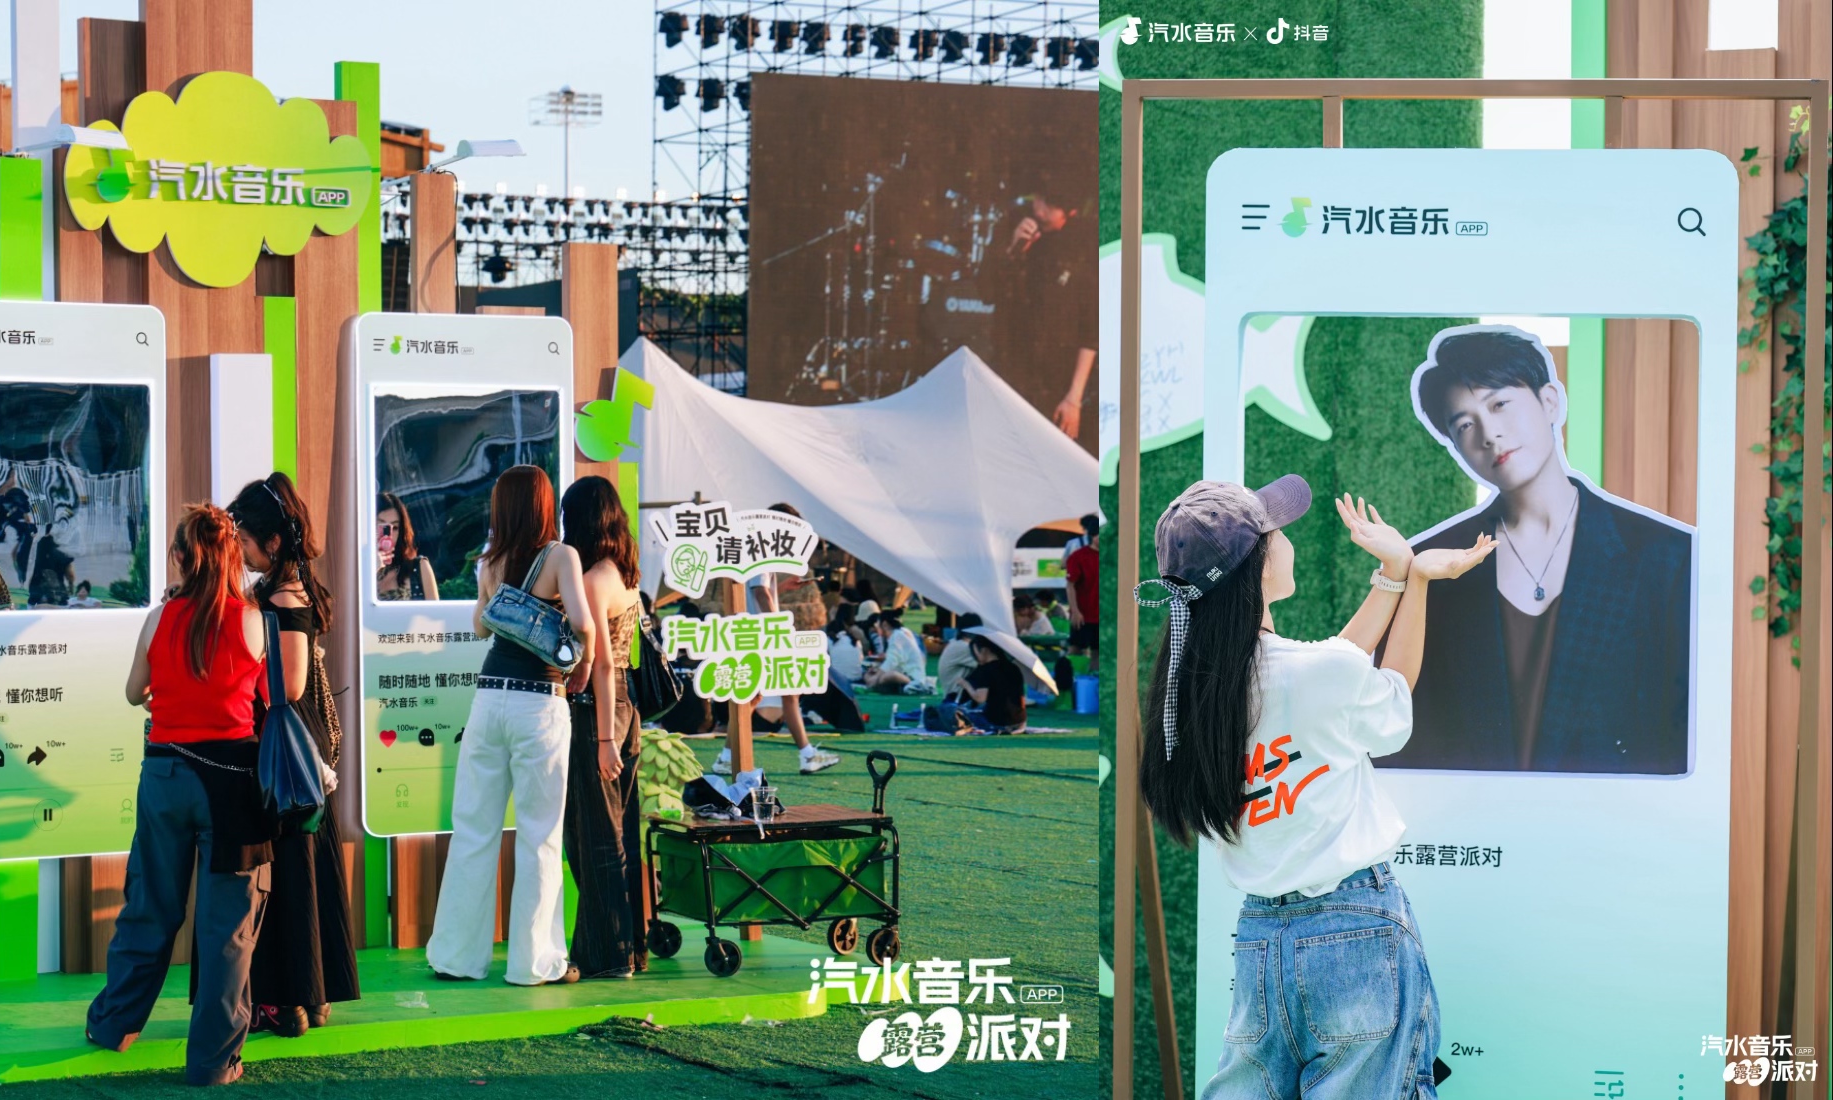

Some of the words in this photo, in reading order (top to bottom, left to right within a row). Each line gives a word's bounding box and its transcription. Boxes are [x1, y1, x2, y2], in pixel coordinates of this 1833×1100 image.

[149, 159, 305, 205] 汽水音乐
[318, 193, 345, 203] APP
[1322, 205, 1449, 235] 汽水音乐
[1460, 224, 1483, 233] APP
[406, 340, 459, 354] 汽水音乐
[675, 507, 730, 538] 宝贝
[715, 529, 796, 565] 请补妆
[378, 633, 415, 643] 欢迎来到
[668, 616, 793, 654] 汽水音乐
[713, 654, 826, 690] 露营派对
[379, 674, 430, 689] 随时随地
[6, 687, 63, 704] 懂你想听
[379, 697, 418, 709] 汽水音乐
[46, 740, 66, 748] 10w+
[1451, 1042, 1484, 1056] 2w+
